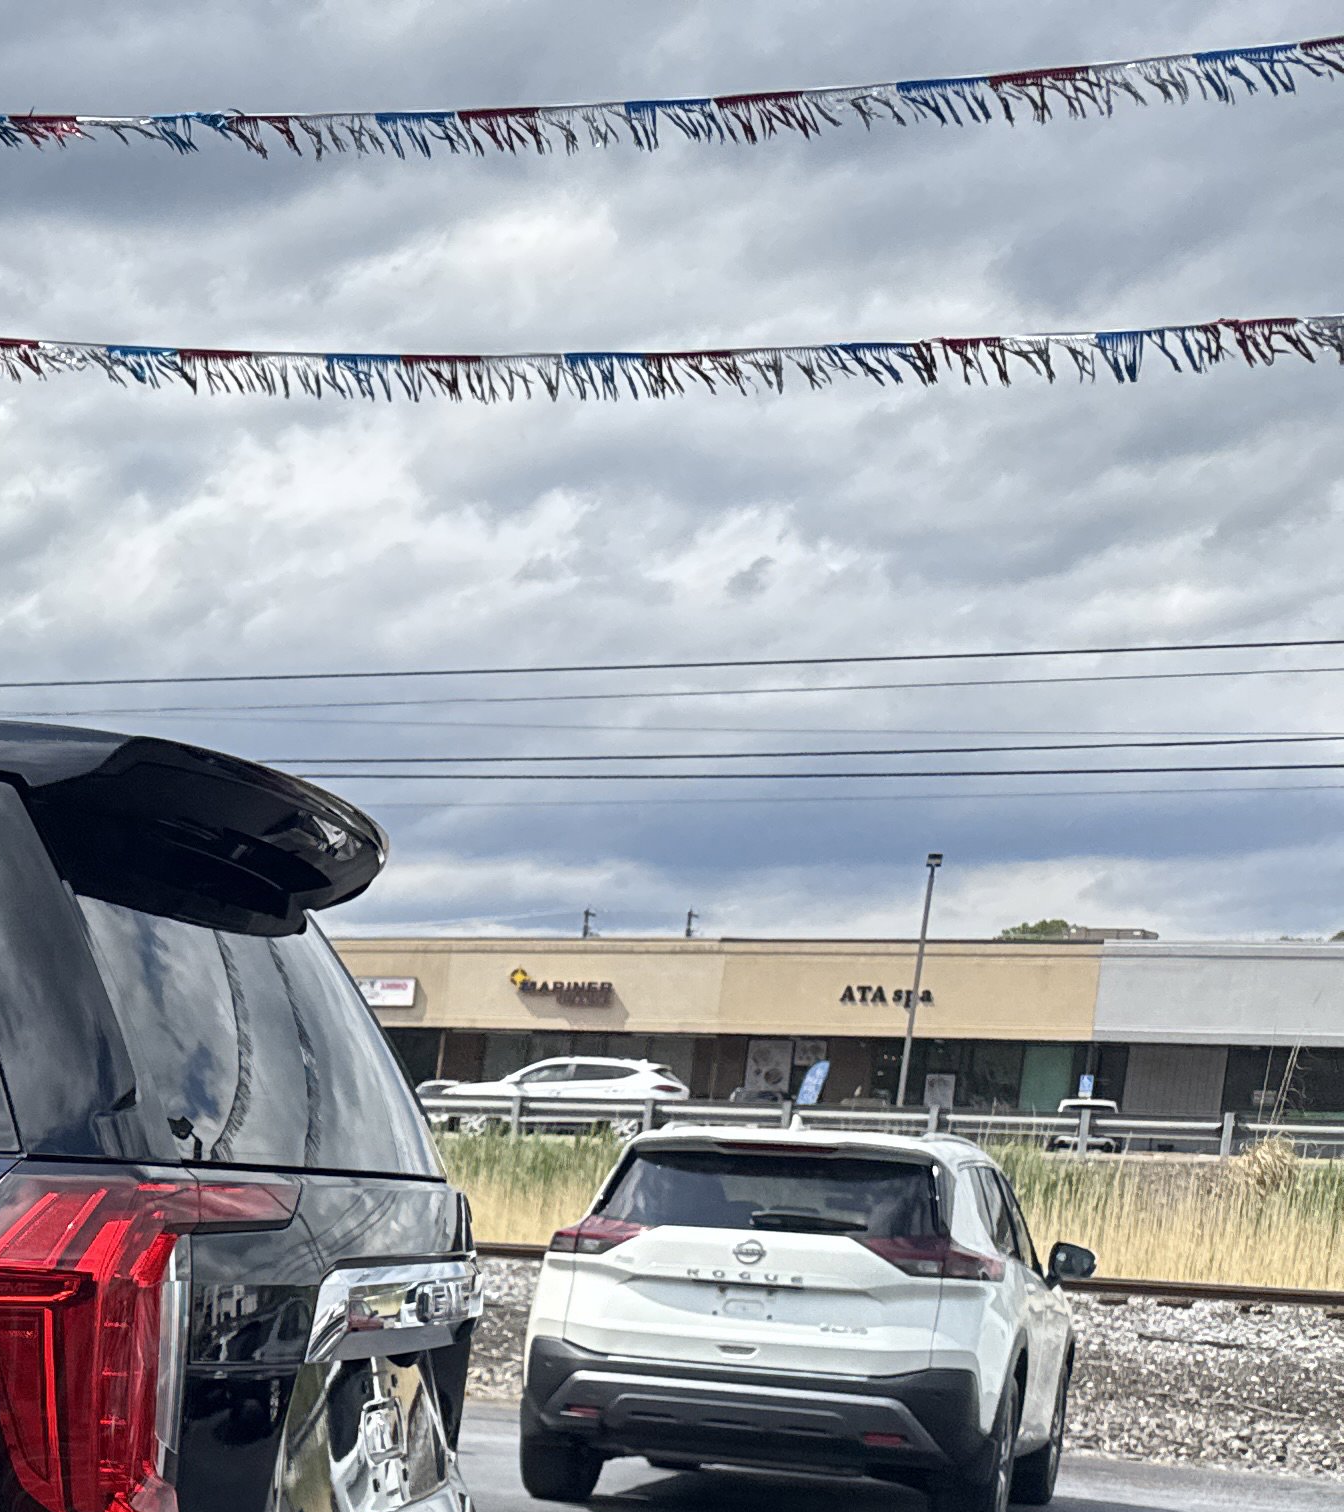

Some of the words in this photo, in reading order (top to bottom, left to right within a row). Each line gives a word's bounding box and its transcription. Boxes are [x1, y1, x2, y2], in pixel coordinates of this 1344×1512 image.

[520, 981, 615, 993] MARINER
[839, 985, 887, 1003] ATA
[686, 1267, 804, 1285] ROGUE
